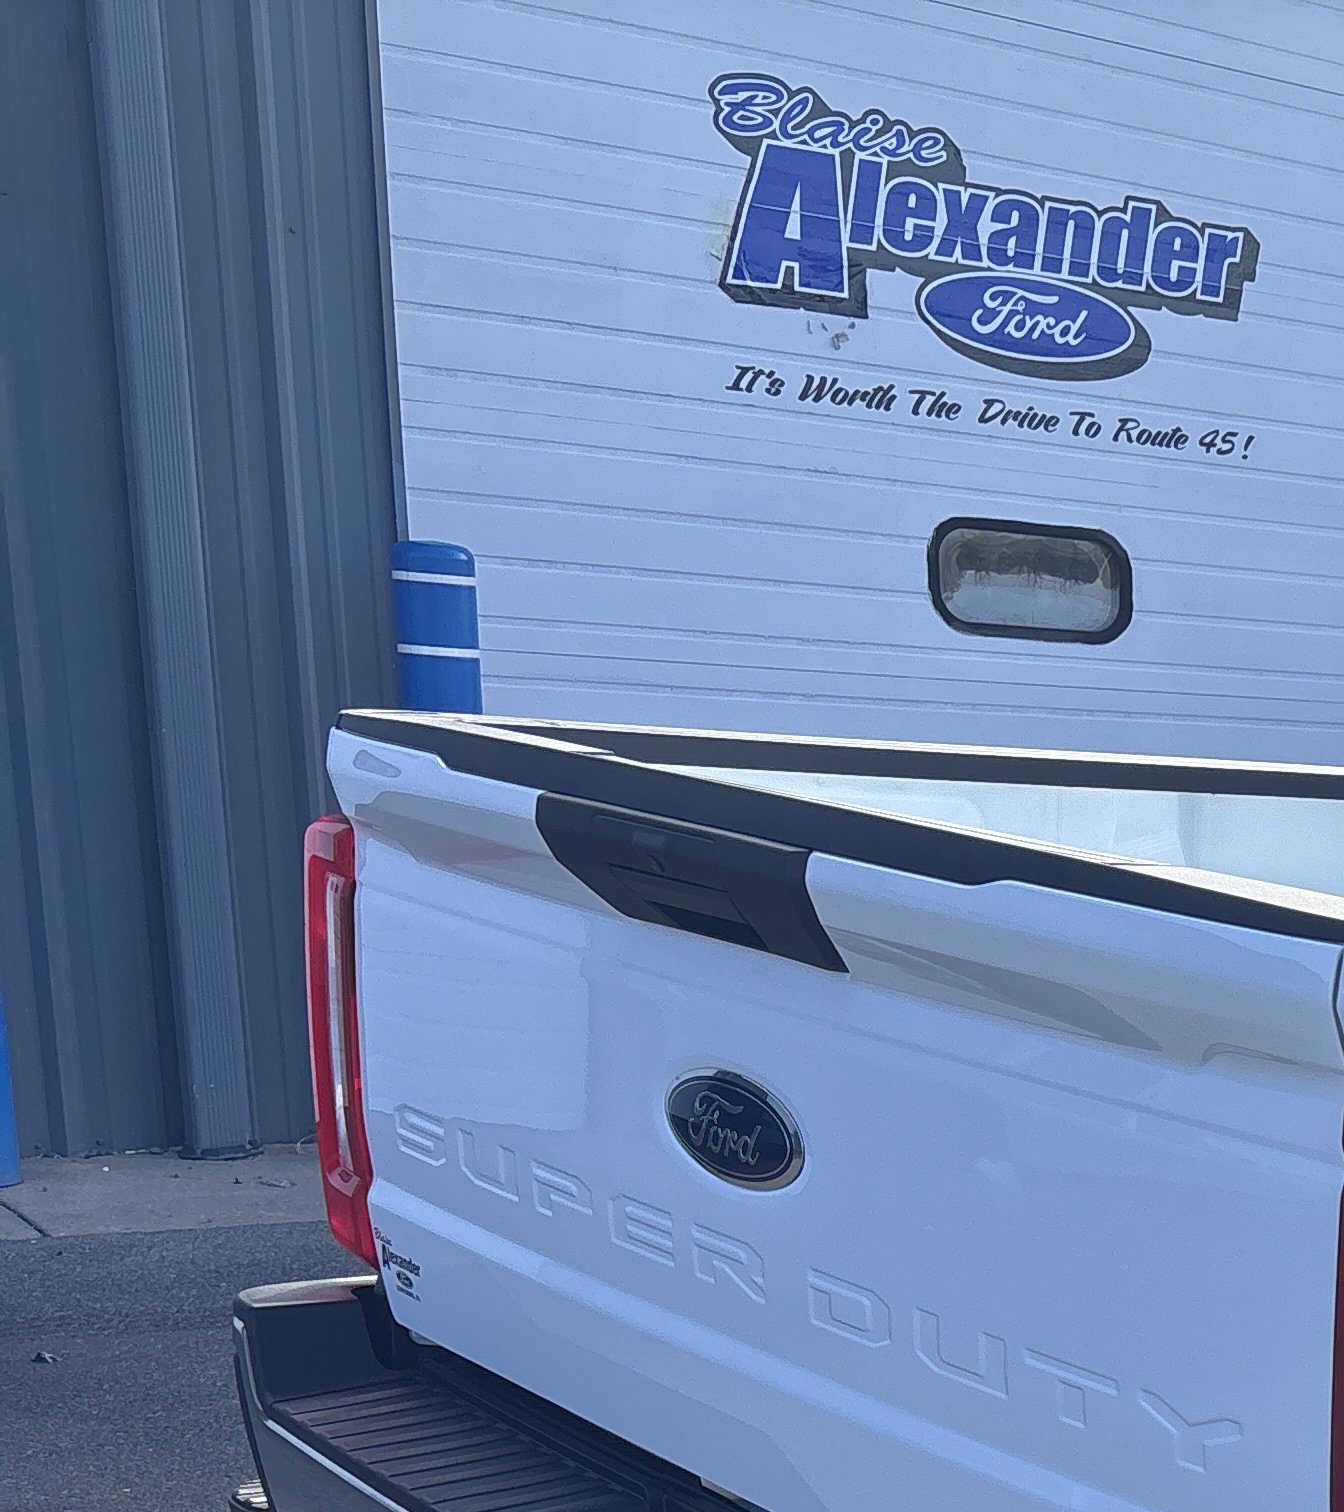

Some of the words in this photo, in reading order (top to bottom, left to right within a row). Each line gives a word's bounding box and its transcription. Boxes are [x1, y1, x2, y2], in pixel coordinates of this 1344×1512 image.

[707, 74, 949, 168] Blaise
[724, 138, 1247, 302] Alexander
[970, 284, 1088, 347] Ford
[724, 362, 785, 399] It's
[797, 372, 898, 414] Worth
[908, 388, 962, 423] The
[977, 397, 1059, 436] Drive
[1067, 409, 1102, 441] To
[1111, 416, 1190, 453] Route
[688, 1090, 762, 1165] Ford
[393, 1102, 767, 1304] SUPER
[806, 1266, 1244, 1473] DUTY
